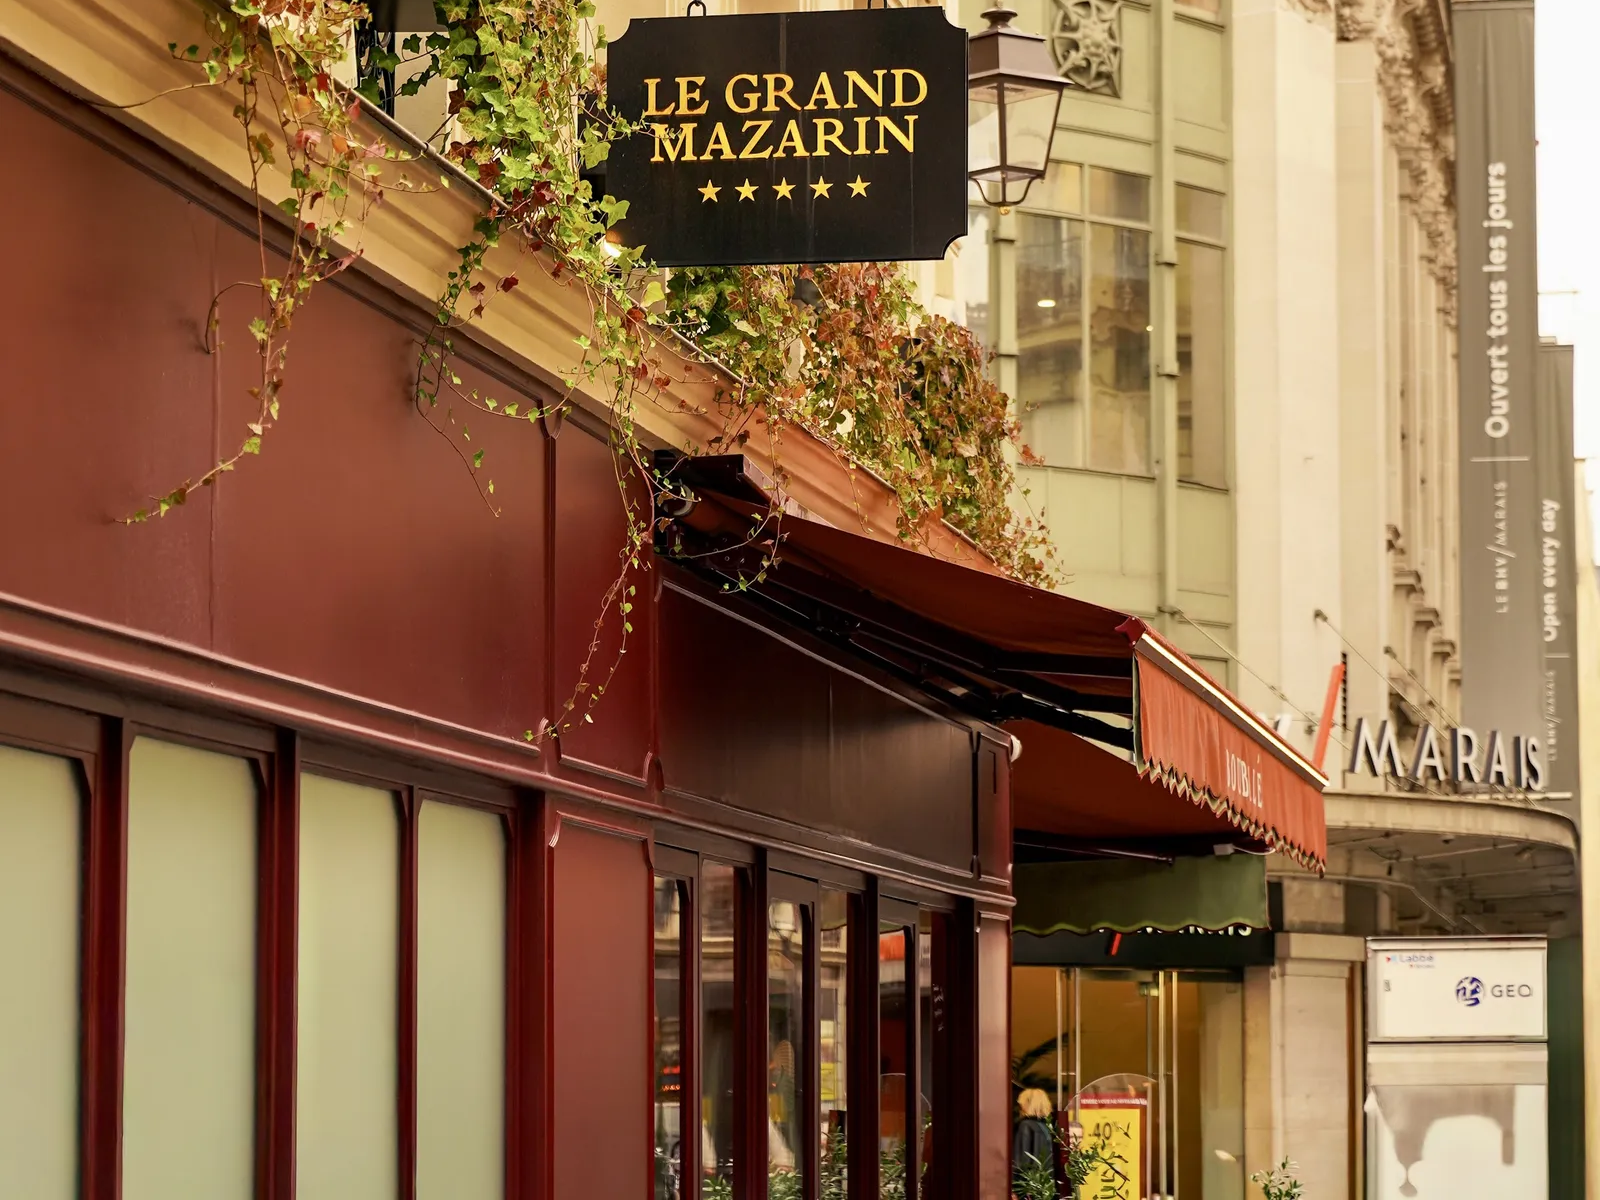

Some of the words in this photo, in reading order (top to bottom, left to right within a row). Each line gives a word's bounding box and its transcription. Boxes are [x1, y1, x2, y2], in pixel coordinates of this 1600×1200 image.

[643, 75, 710, 116] LE
[724, 68, 929, 114] GRAND
[650, 114, 919, 162] MAZARIN
[1482, 161, 1513, 230] jours
[1482, 235, 1508, 273] les
[1486, 279, 1508, 339] tous
[1484, 344, 1510, 439] Ouvert
[1542, 498, 1560, 533] day
[1543, 537, 1561, 588] every
[1496, 595, 1509, 613] LE
[1348, 716, 1545, 792] MARAIS
